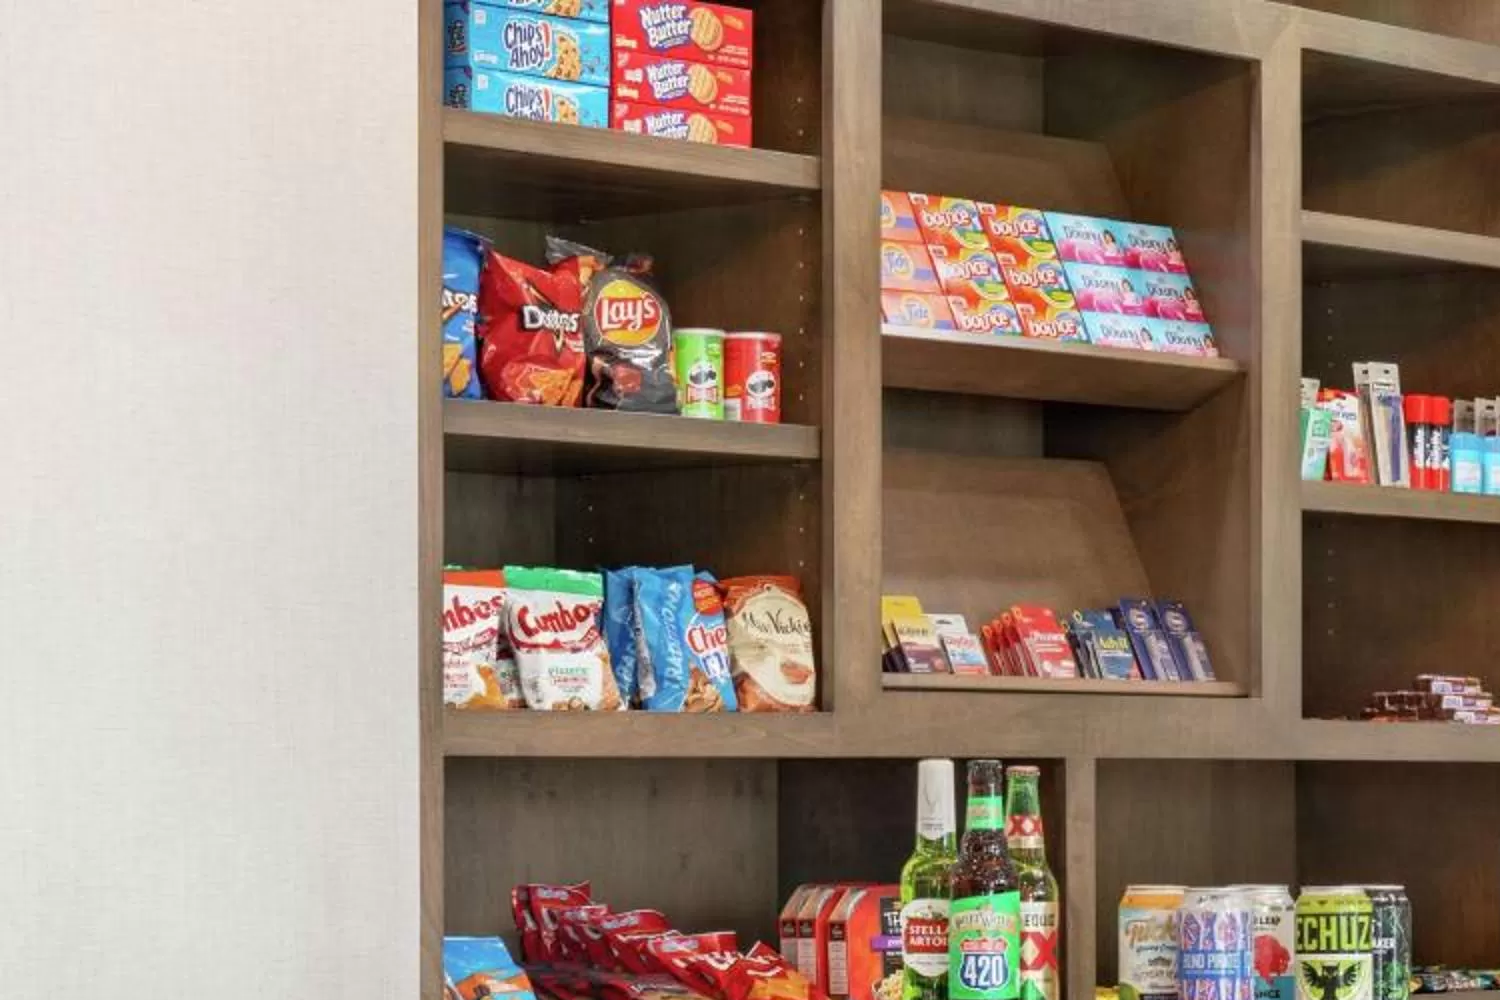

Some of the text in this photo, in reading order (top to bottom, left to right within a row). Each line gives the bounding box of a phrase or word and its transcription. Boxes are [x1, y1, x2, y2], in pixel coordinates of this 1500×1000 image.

[503, 21, 543, 48] Chips
[523, 305, 579, 333] Doritos
[599, 291, 657, 332] Lay's
[963, 955, 1004, 987] 420
